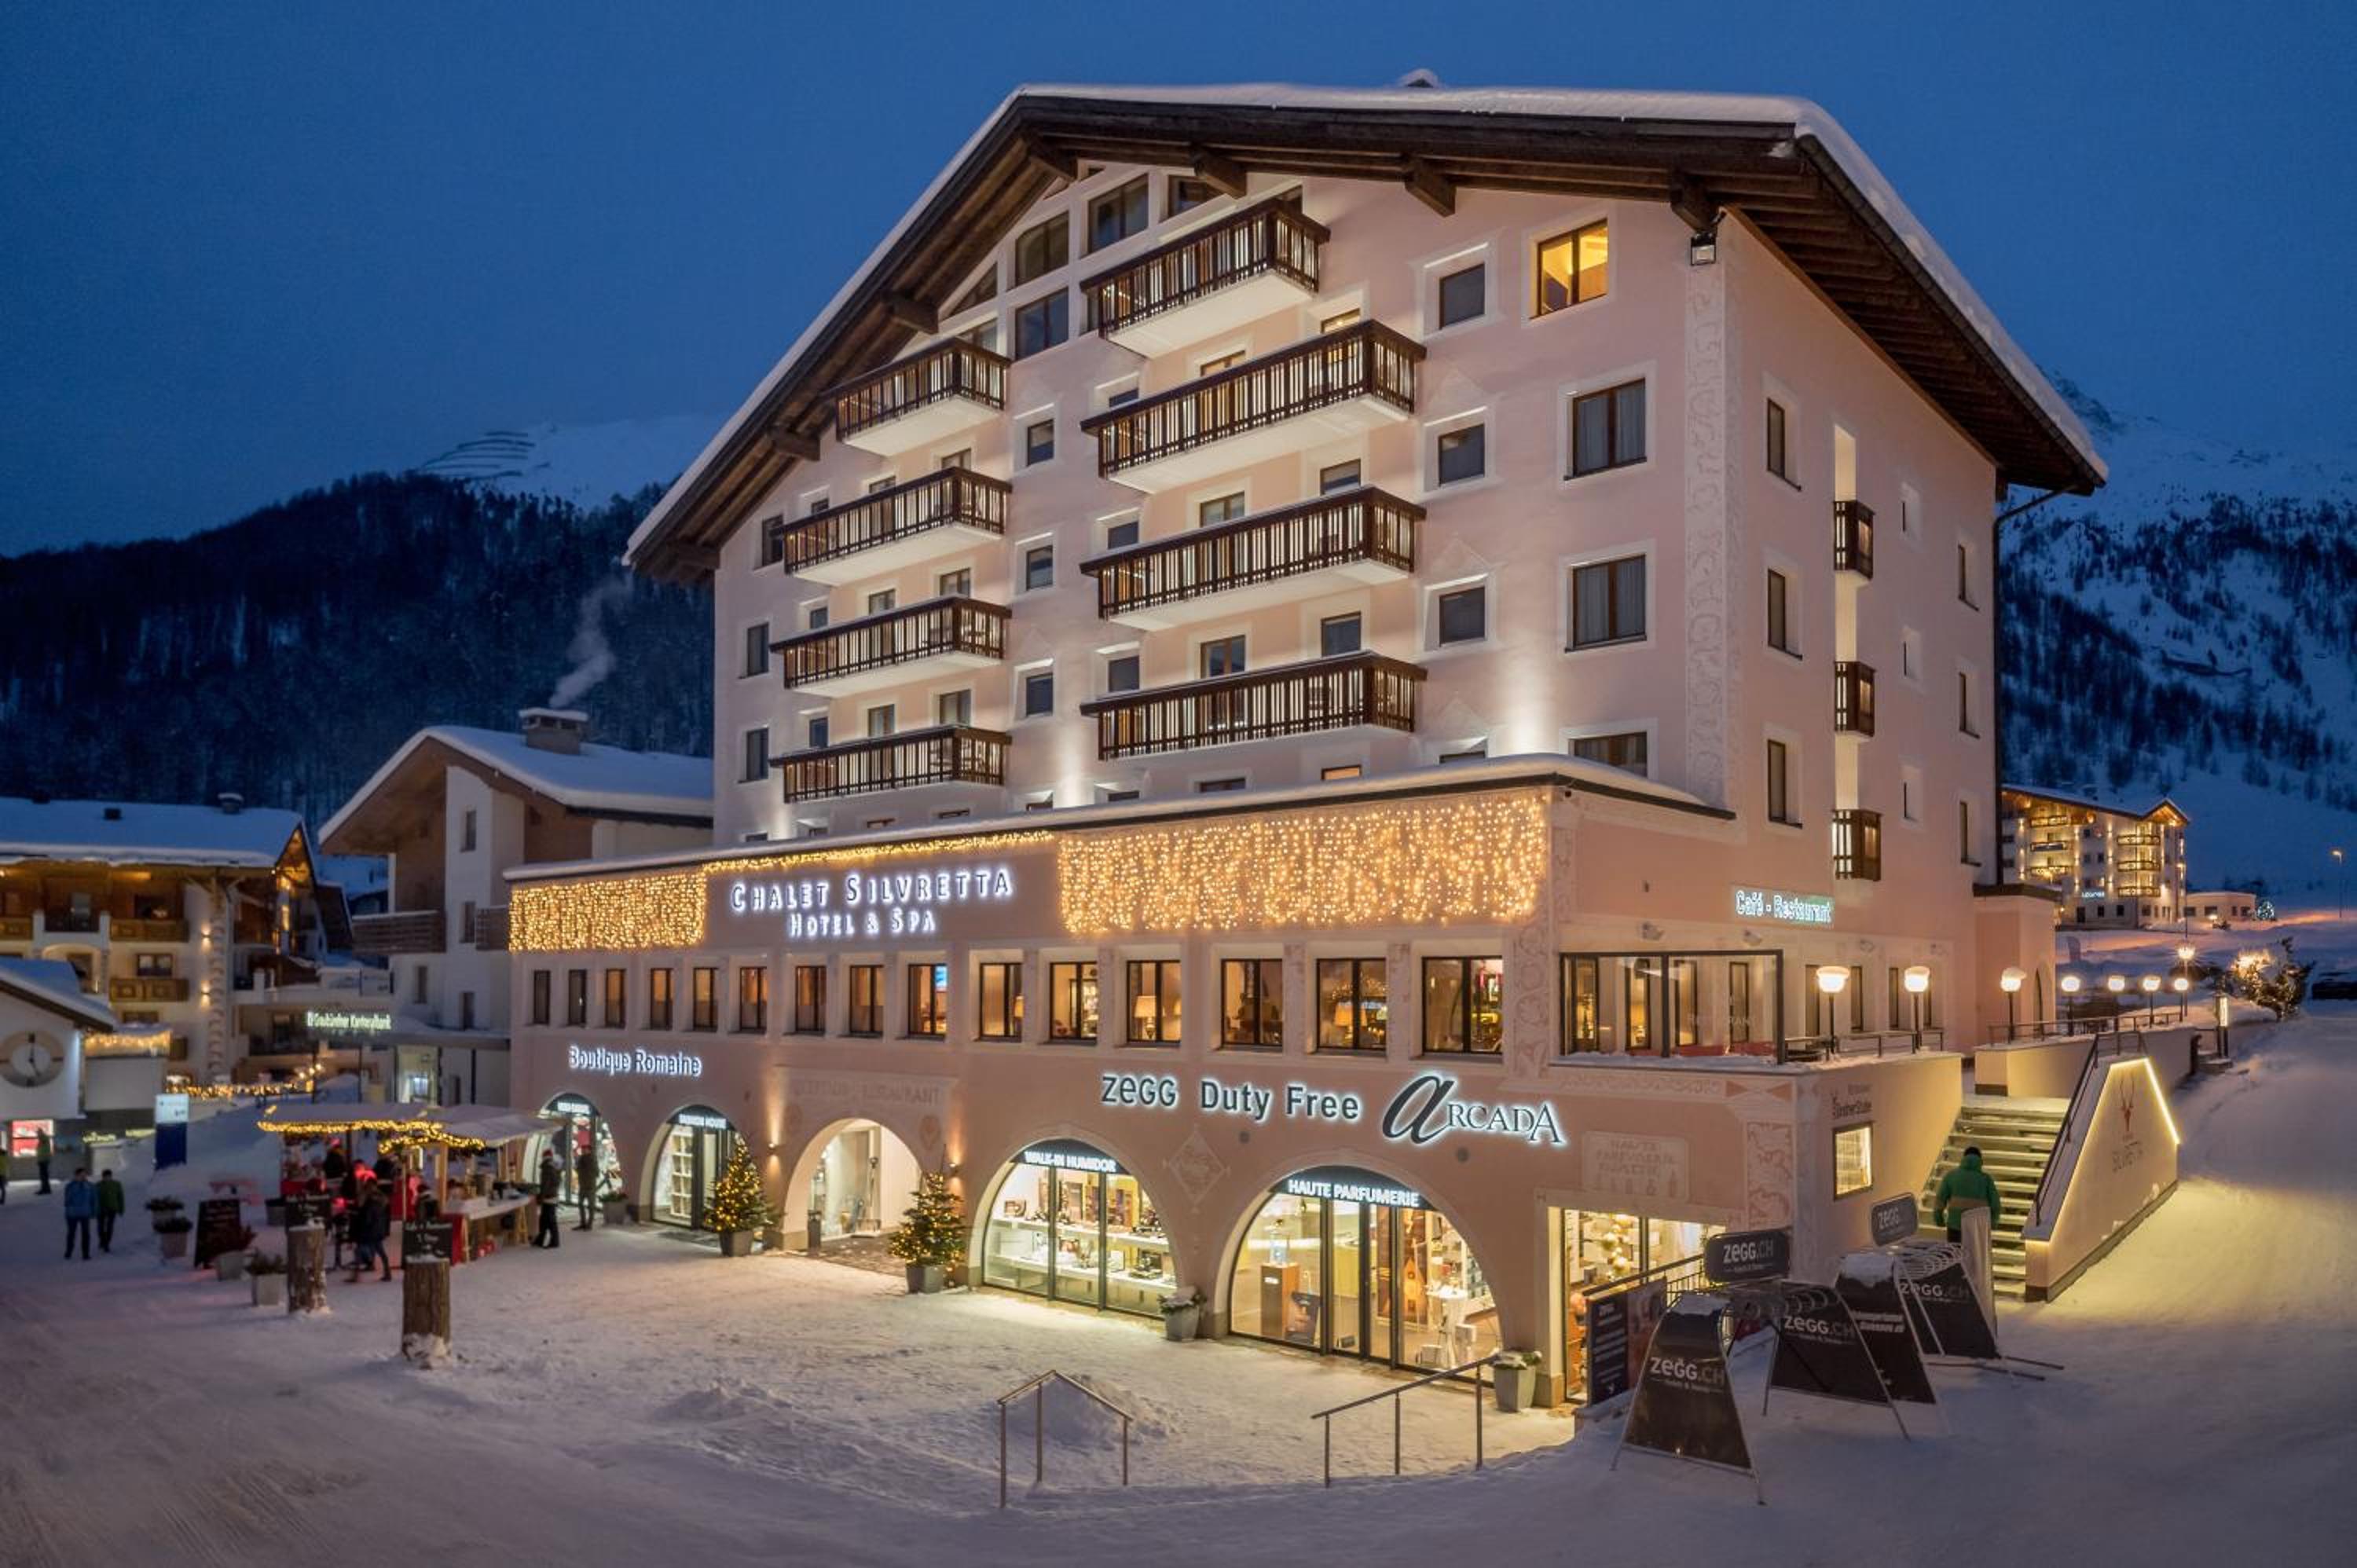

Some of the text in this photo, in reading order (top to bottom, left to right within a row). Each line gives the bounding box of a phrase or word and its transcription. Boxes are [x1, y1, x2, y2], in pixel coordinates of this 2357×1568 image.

[731, 867, 1013, 911] CHALET SILVRETTA
[789, 908, 937, 937] HOTEL & SPA
[569, 1046, 702, 1077] Boutique Romaine
[1200, 1080, 1270, 1121] Duty
[1286, 1085, 1359, 1119] Free
[1288, 1179, 1420, 1207] HAUTE PARFUMERIE
